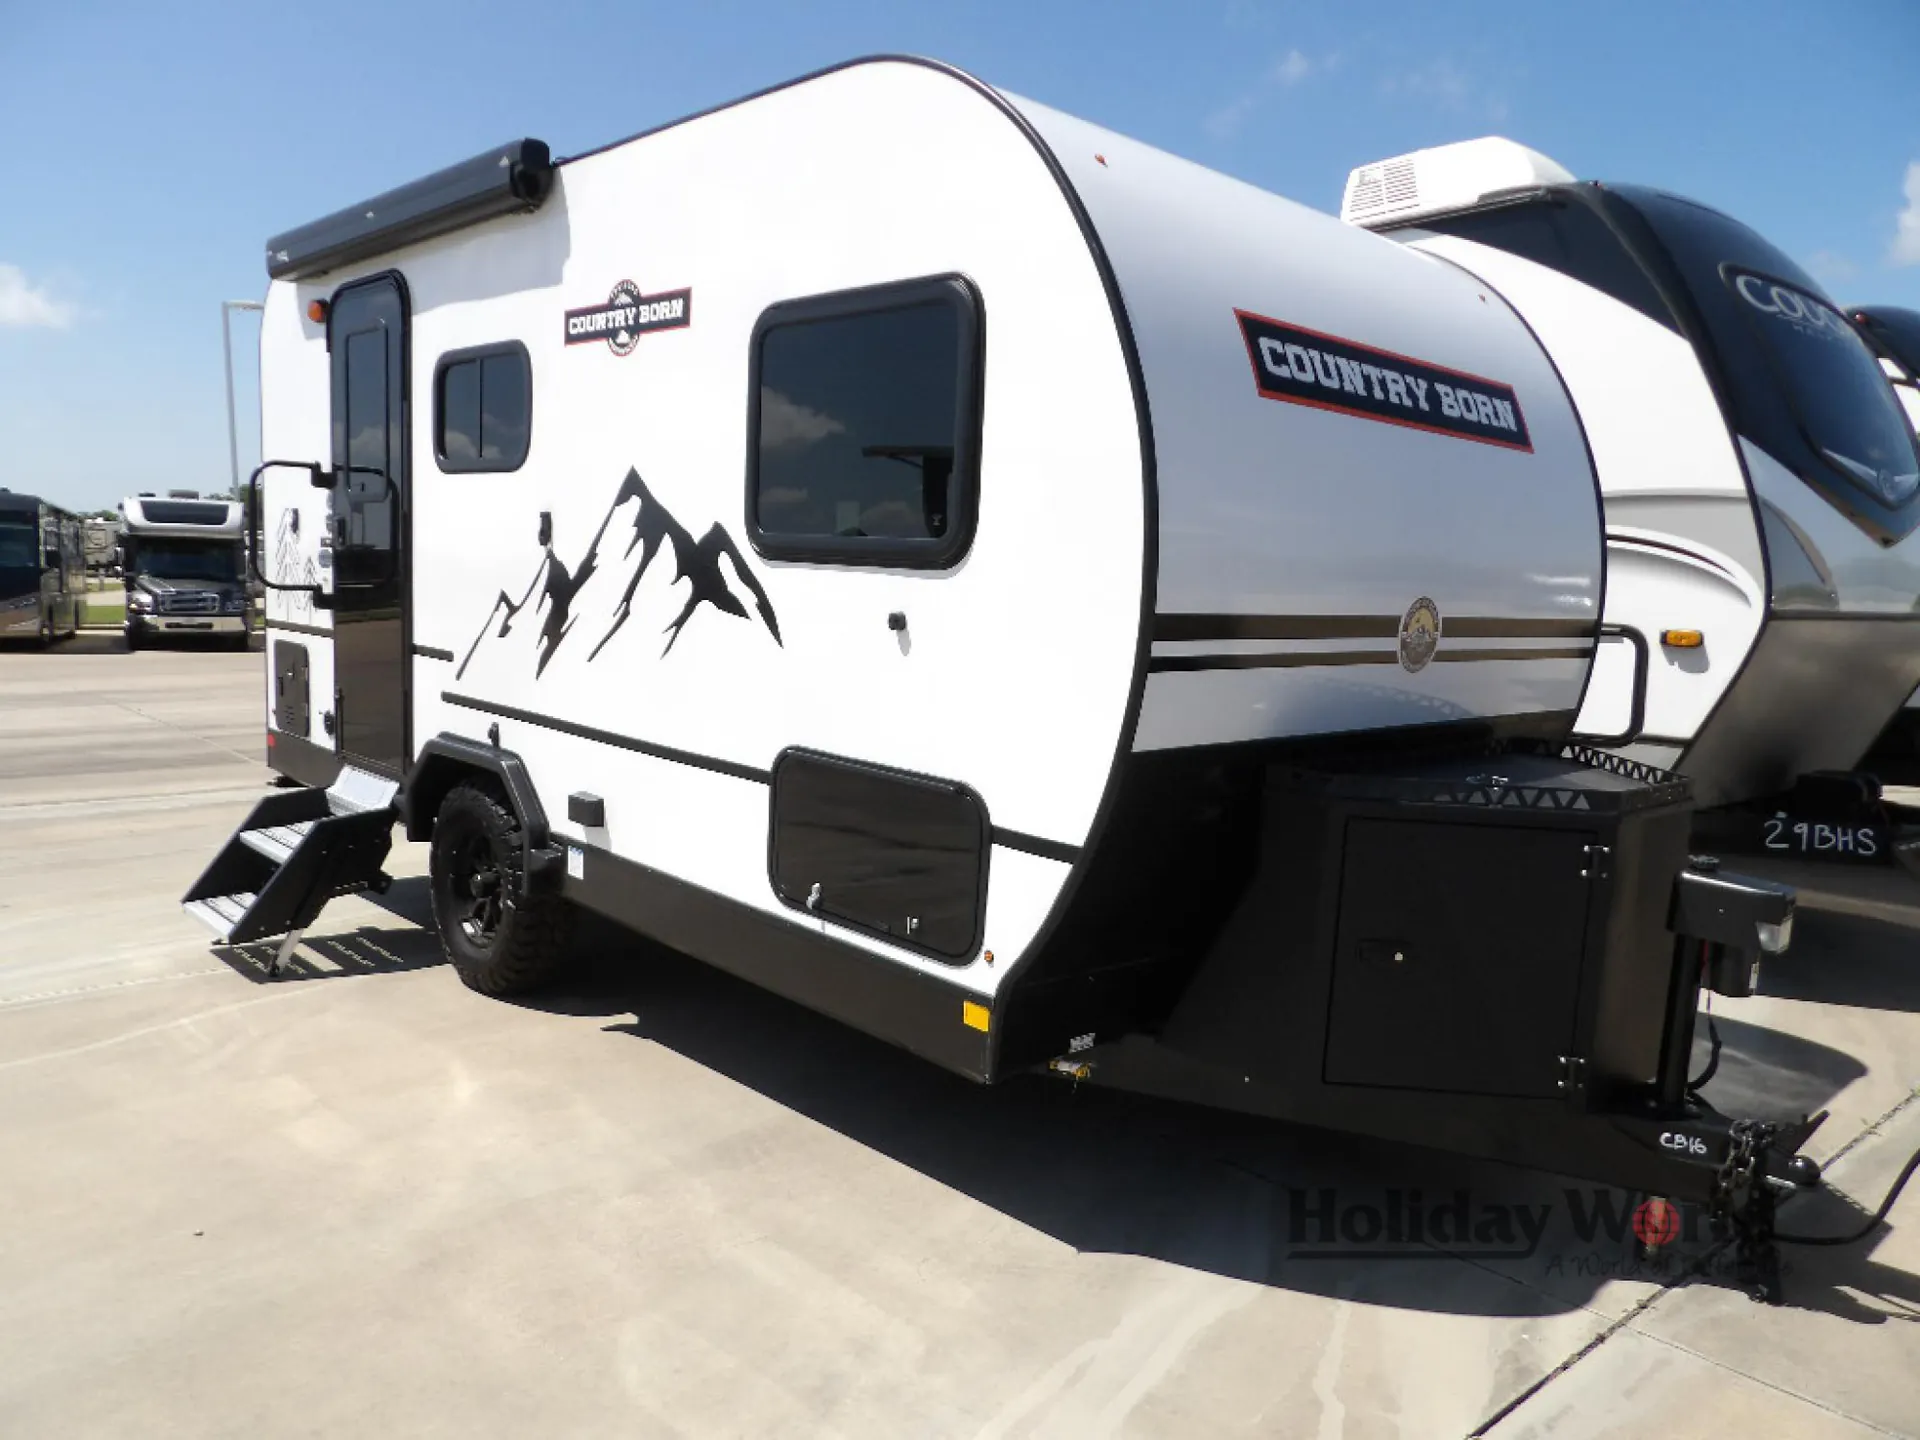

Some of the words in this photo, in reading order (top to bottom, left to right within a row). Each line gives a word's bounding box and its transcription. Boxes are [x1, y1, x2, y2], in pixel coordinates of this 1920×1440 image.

[568, 307, 637, 335] COUNTRY
[639, 297, 684, 324] BORN
[1258, 335, 1432, 412] COUNTRY
[1434, 383, 1518, 432] BORN
[1763, 818, 1877, 855] 29BHS
[1659, 1132, 1707, 1154] CB16
